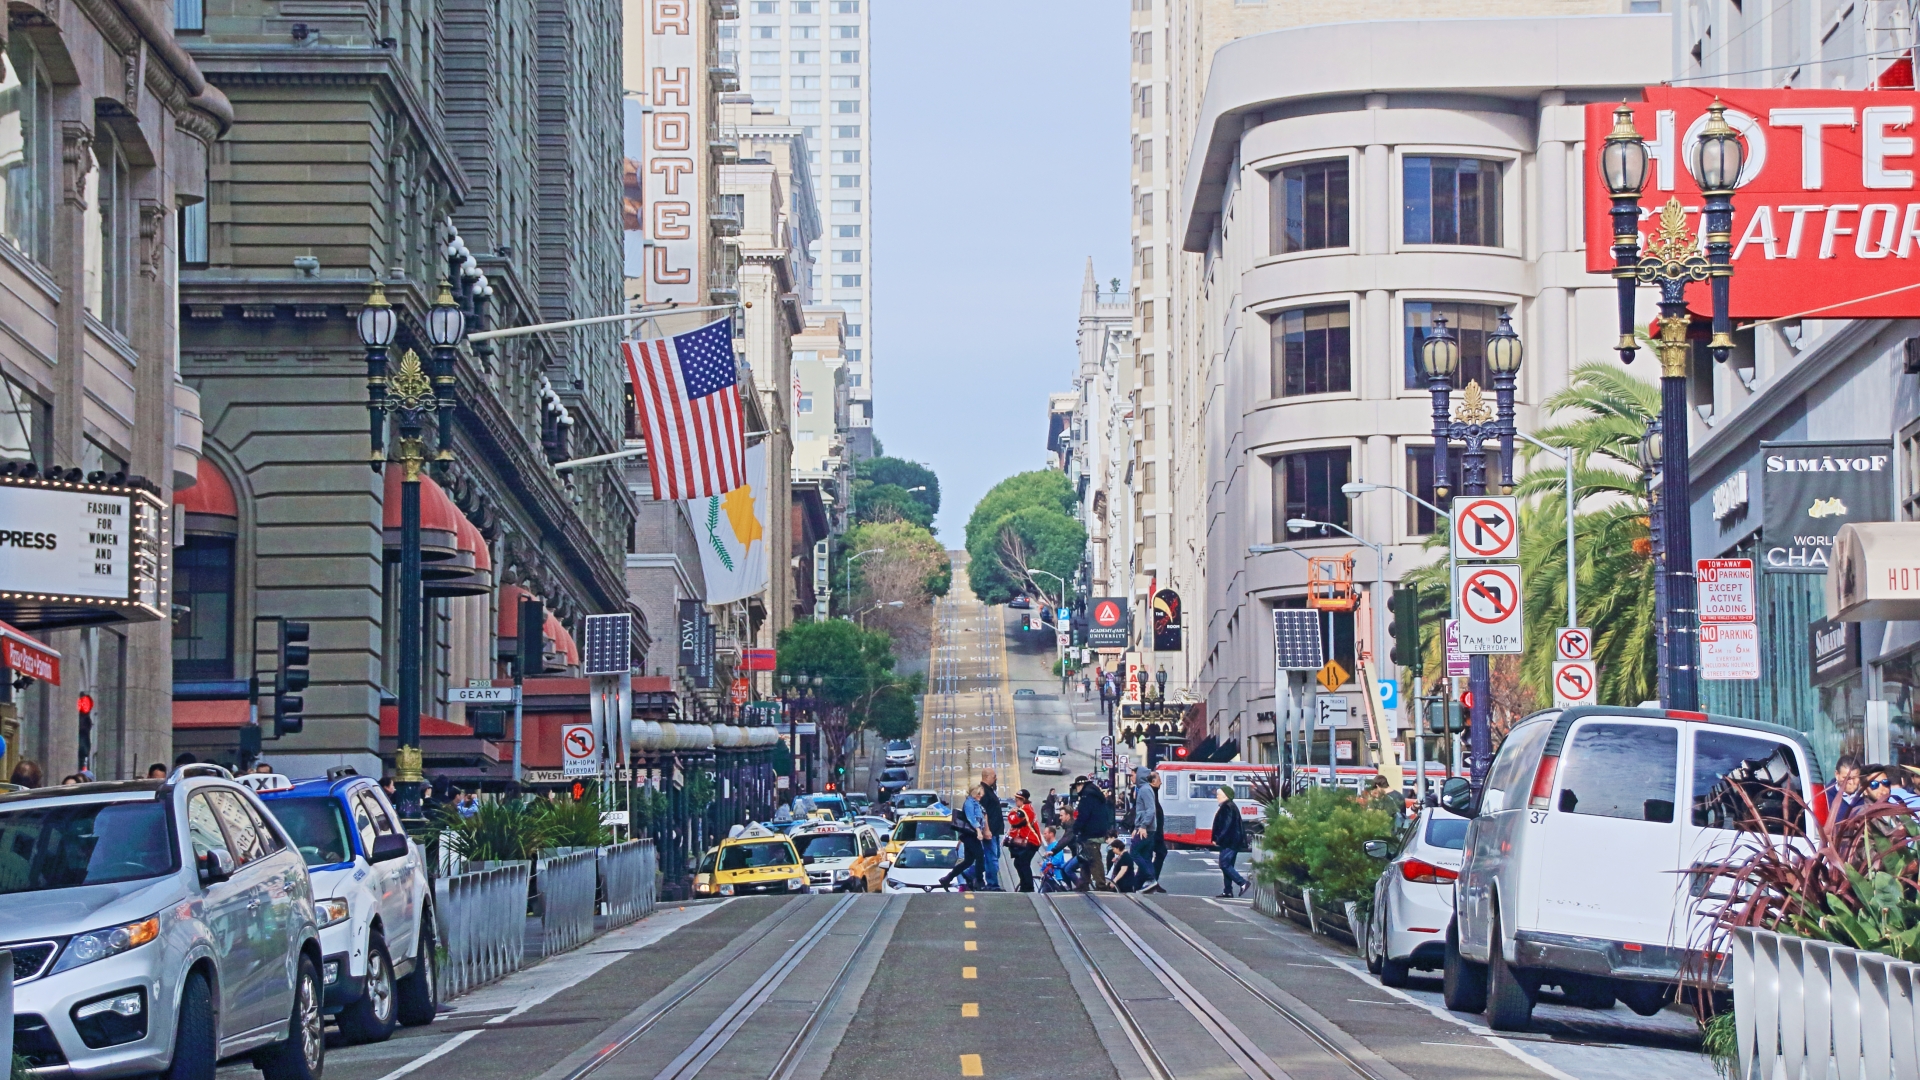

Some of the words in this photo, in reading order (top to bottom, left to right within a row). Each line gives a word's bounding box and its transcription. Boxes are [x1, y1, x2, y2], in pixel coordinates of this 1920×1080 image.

[650, 67, 693, 284] HOTEL
[87, 502, 122, 516] FASHION
[97, 518, 112, 530] FOR
[0, 529, 57, 550] PRESS
[89, 533, 118, 545] WOMEN
[96, 549, 112, 560] AND
[95, 563, 112, 575] MEN
[1707, 560, 1742, 568] TOW-AWAY
[1699, 568, 1717, 582] NO
[1719, 570, 1750, 579] PARKING
[1888, 568, 1920, 591] HOT
[1708, 583, 1743, 592] EXCEPT
[1710, 594, 1743, 602] ACTIVE
[1706, 604, 1747, 613] LOADING
[682, 618, 694, 650] DSW
[1701, 626, 1717, 641] NO
[1719, 630, 1753, 640] PARKING
[476, 679, 490, 687] 300
[1129, 664, 1138, 701] PARK
[459, 690, 501, 699] GEARY
[565, 759, 596, 767] 7AM-10PM
[565, 767, 595, 775] EVERYDAY
[240, 777, 278, 790] AXI
[1530, 811, 1548, 825] 37
